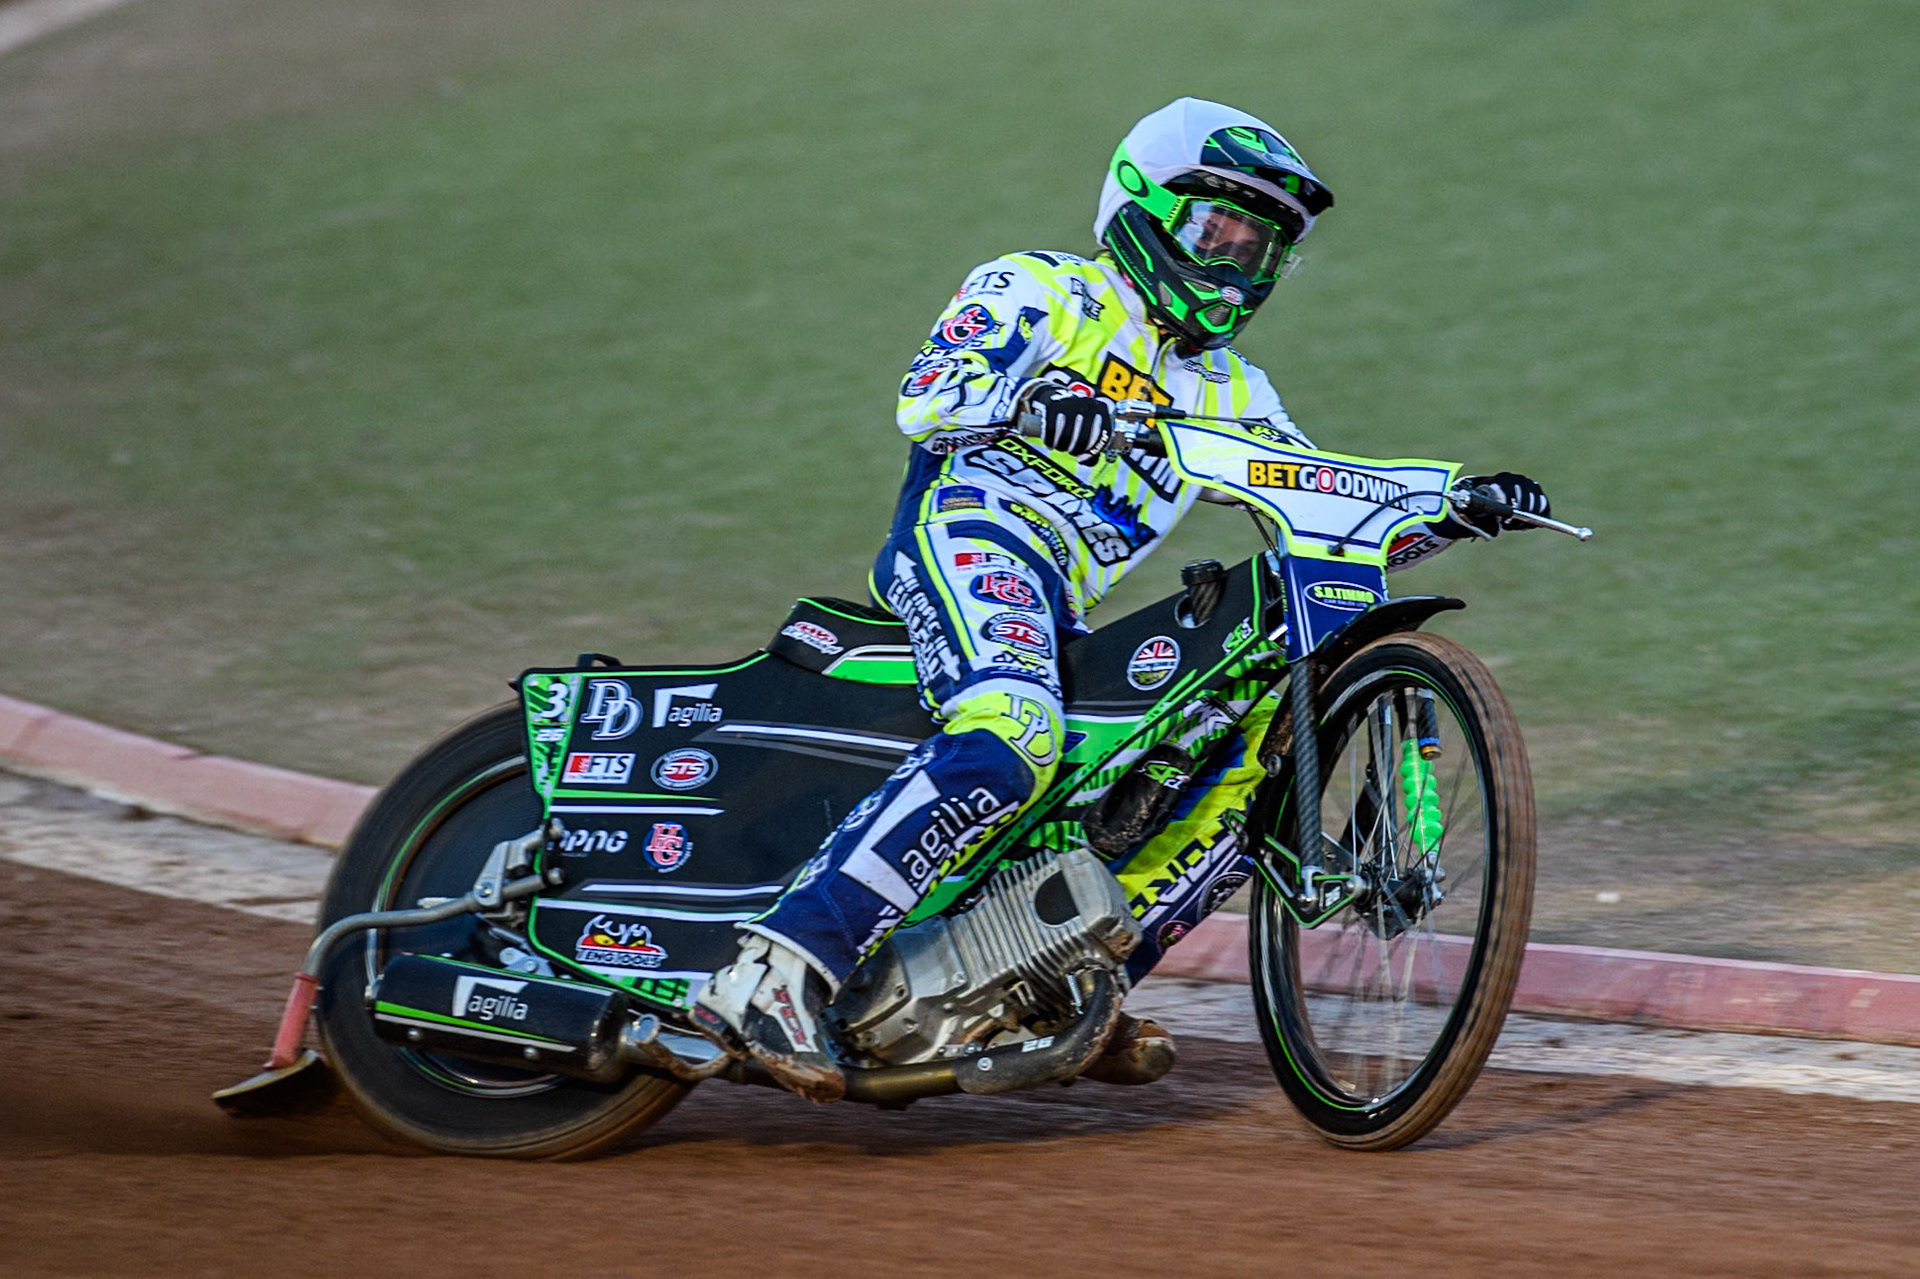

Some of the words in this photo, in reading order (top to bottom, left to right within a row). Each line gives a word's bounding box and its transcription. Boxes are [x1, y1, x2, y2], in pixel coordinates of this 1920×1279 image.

[996, 438, 1096, 499] OXFORD
[993, 622, 1047, 648] STS
[540, 682, 569, 718] 3
[668, 702, 722, 728] agilia
[587, 755, 630, 774] FTS
[662, 762, 705, 775] STS
[901, 787, 1002, 882] agilia
[467, 994, 529, 1021] agilia
